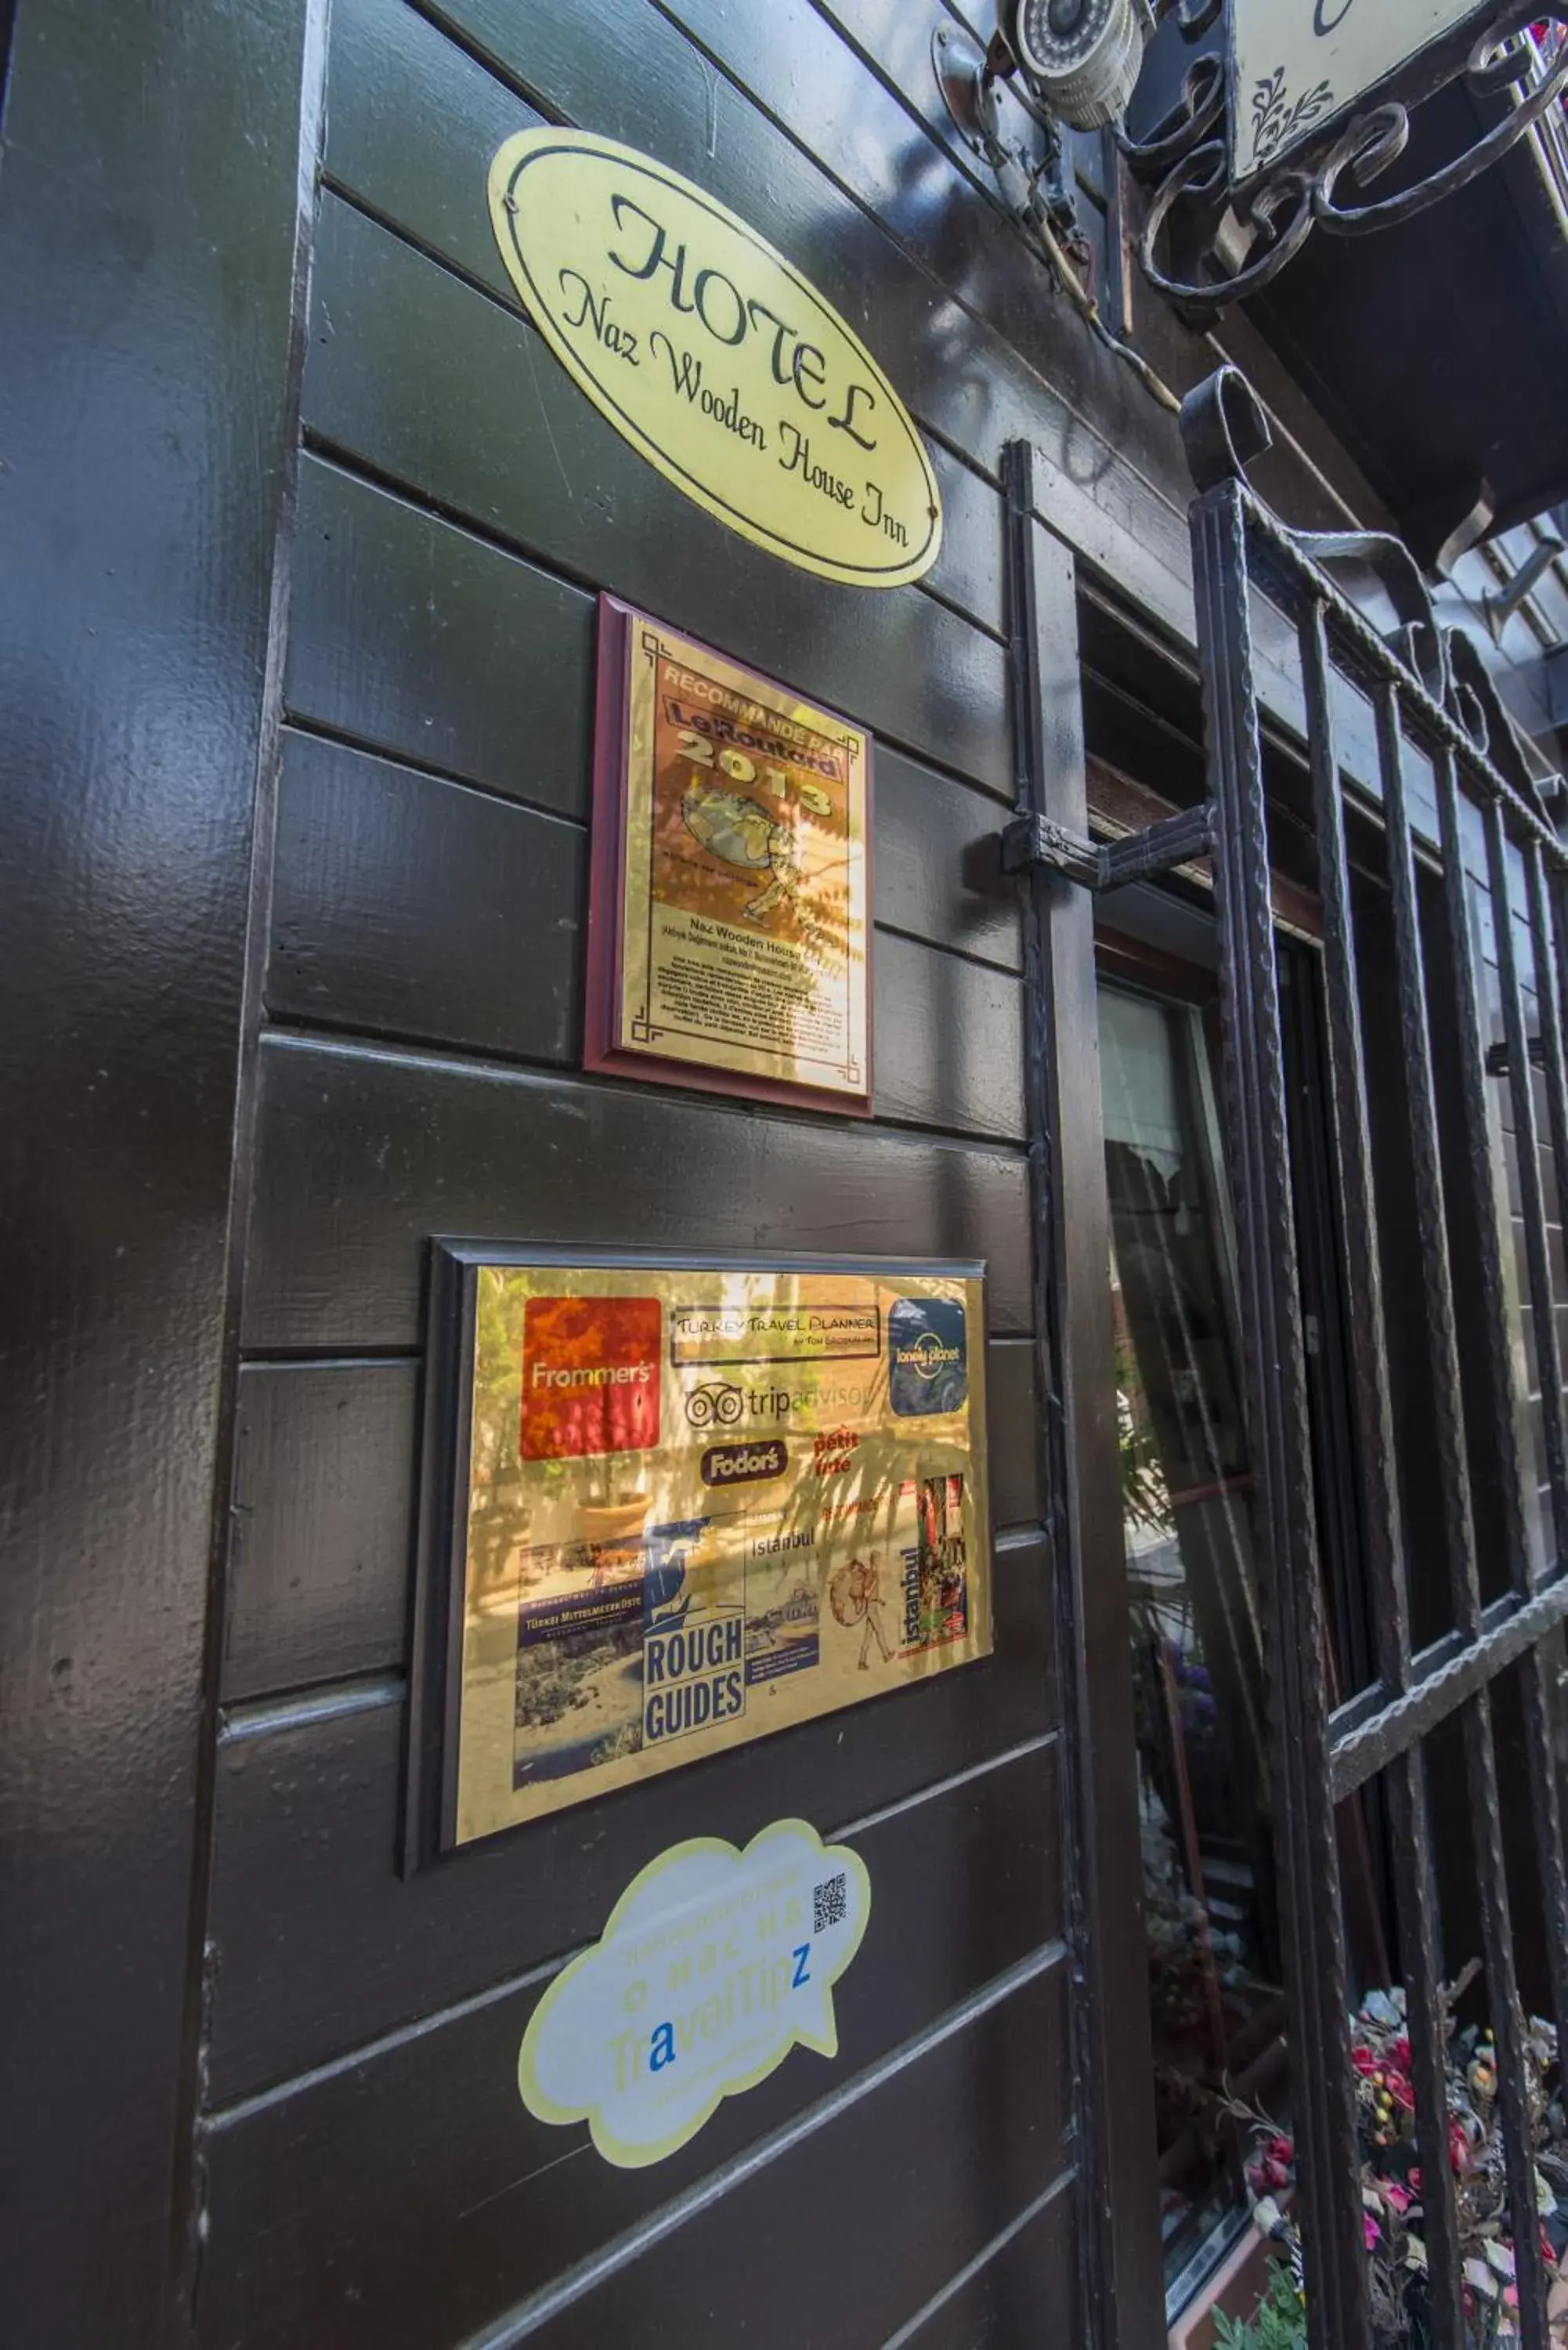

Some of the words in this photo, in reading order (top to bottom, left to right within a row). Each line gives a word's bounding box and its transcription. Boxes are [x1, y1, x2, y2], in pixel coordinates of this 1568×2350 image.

[609, 193, 876, 450] HOTEL
[559, 269, 640, 367] Naz
[650, 331, 767, 450] Wooden
[779, 421, 854, 511] House
[862, 483, 909, 548] Inn
[690, 917, 714, 935] Naz
[716, 926, 764, 949] Wooden
[767, 941, 801, 960] House
[749, 1317, 806, 1332] TRAVEL
[809, 1314, 876, 1332] PLANNER
[896, 1346, 927, 1367] lonely
[928, 1346, 960, 1366] planet
[647, 1618, 742, 1685] ROUGH
[645, 1671, 742, 1740] GUIDES
